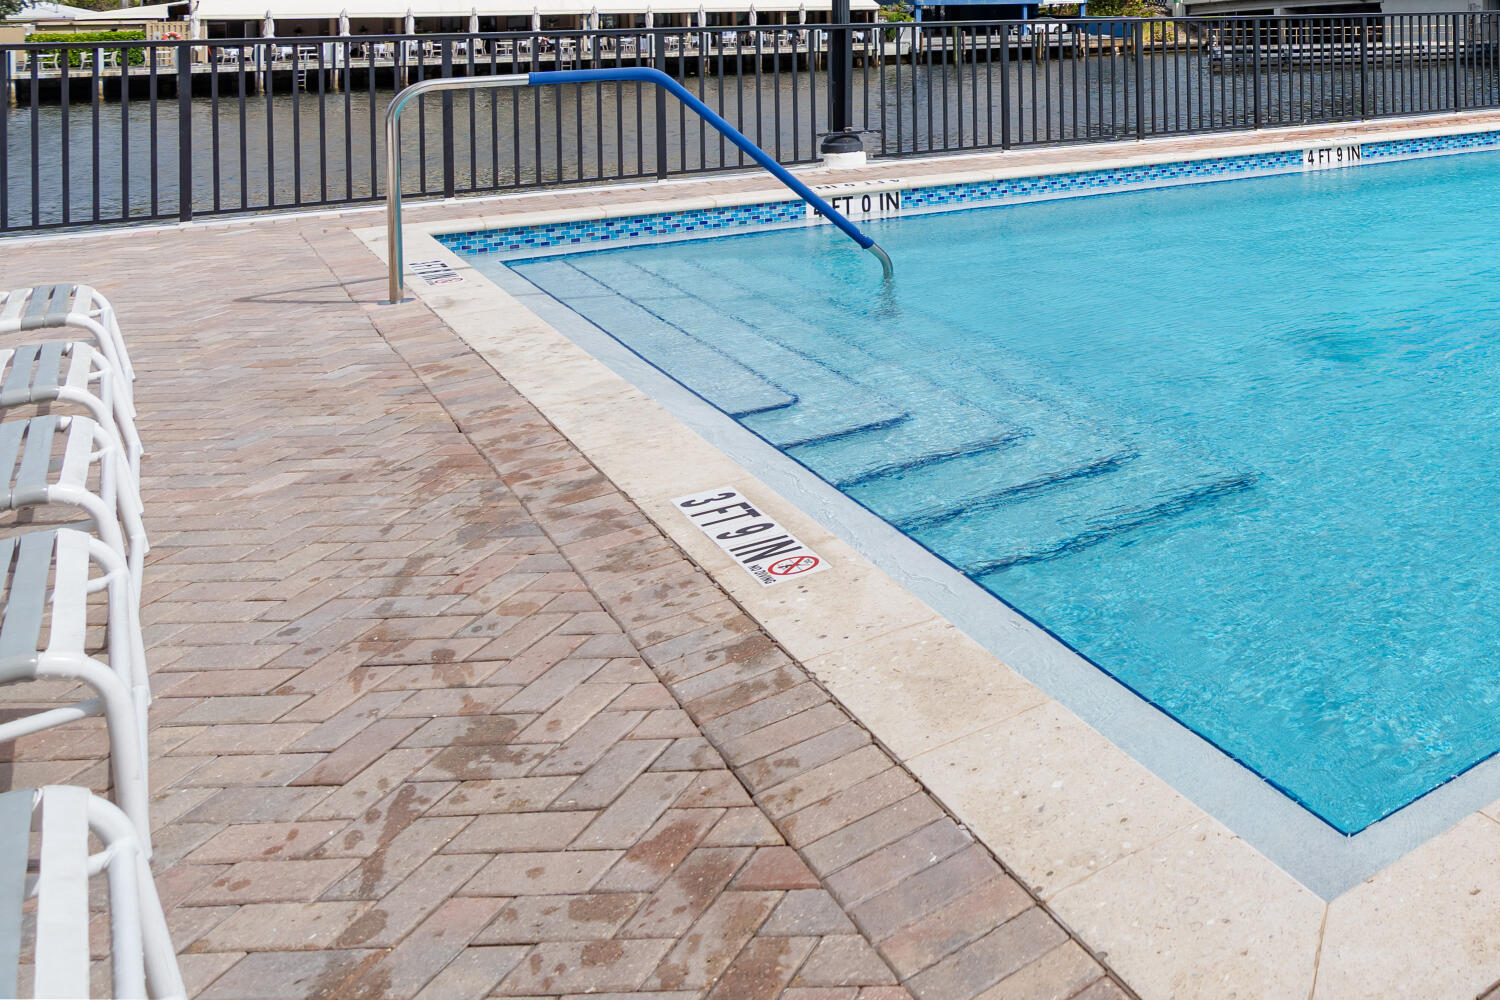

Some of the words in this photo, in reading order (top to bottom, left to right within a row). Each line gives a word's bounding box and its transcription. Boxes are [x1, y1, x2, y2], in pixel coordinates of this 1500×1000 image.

[1308, 150, 1314, 165] 4
[1318, 148, 1332, 164] FT
[1336, 147, 1343, 161] 9
[1347, 145, 1360, 160] IN
[832, 195, 853, 214] FT
[880, 191, 900, 211] IN
[680, 492, 736, 507] 3
[690, 502, 762, 527] FT
[716, 522, 775, 540] 9
[729, 535, 803, 564] IN
